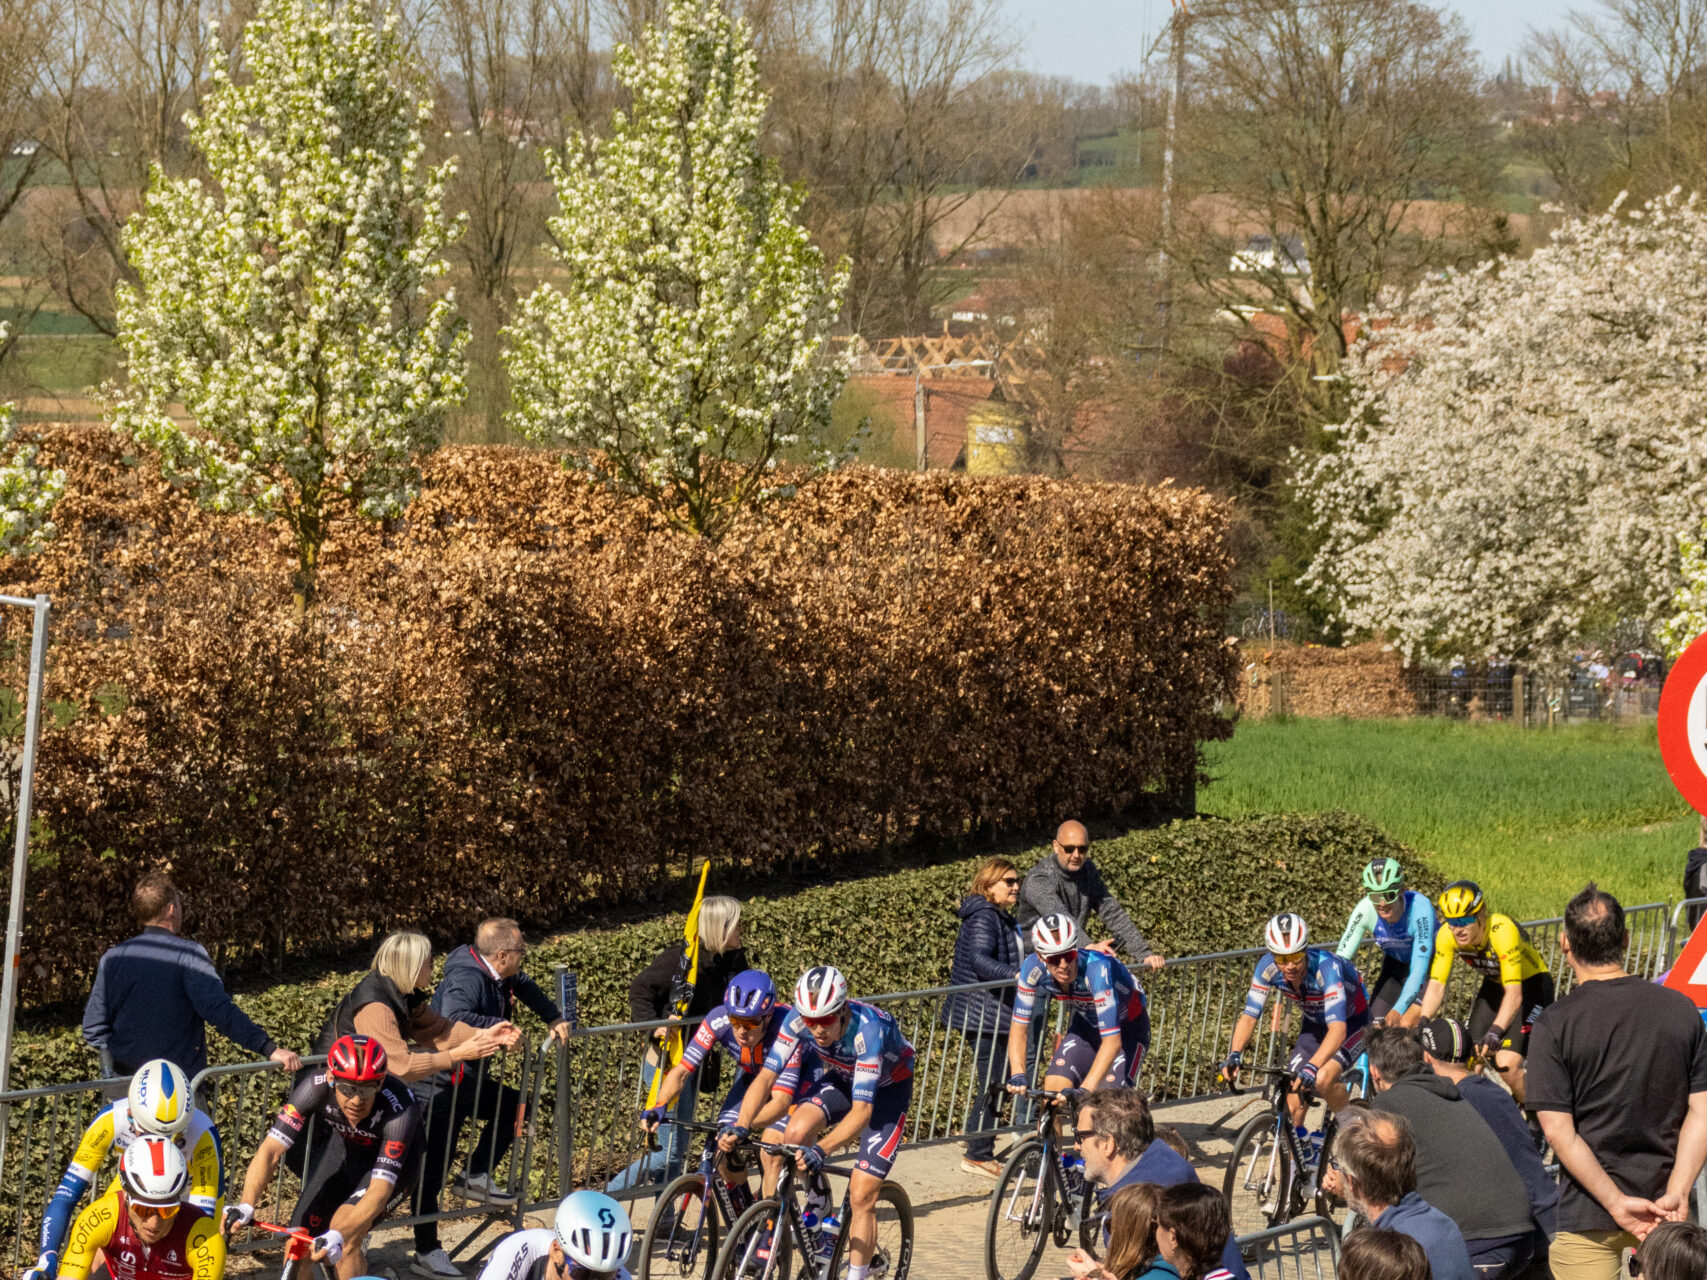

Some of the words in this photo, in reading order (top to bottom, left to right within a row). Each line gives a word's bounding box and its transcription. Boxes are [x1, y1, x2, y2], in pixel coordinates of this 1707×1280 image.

[138, 1069, 150, 1108] RUDY
[381, 1088, 404, 1114] BMC
[714, 1178, 738, 1225] LAPIER
